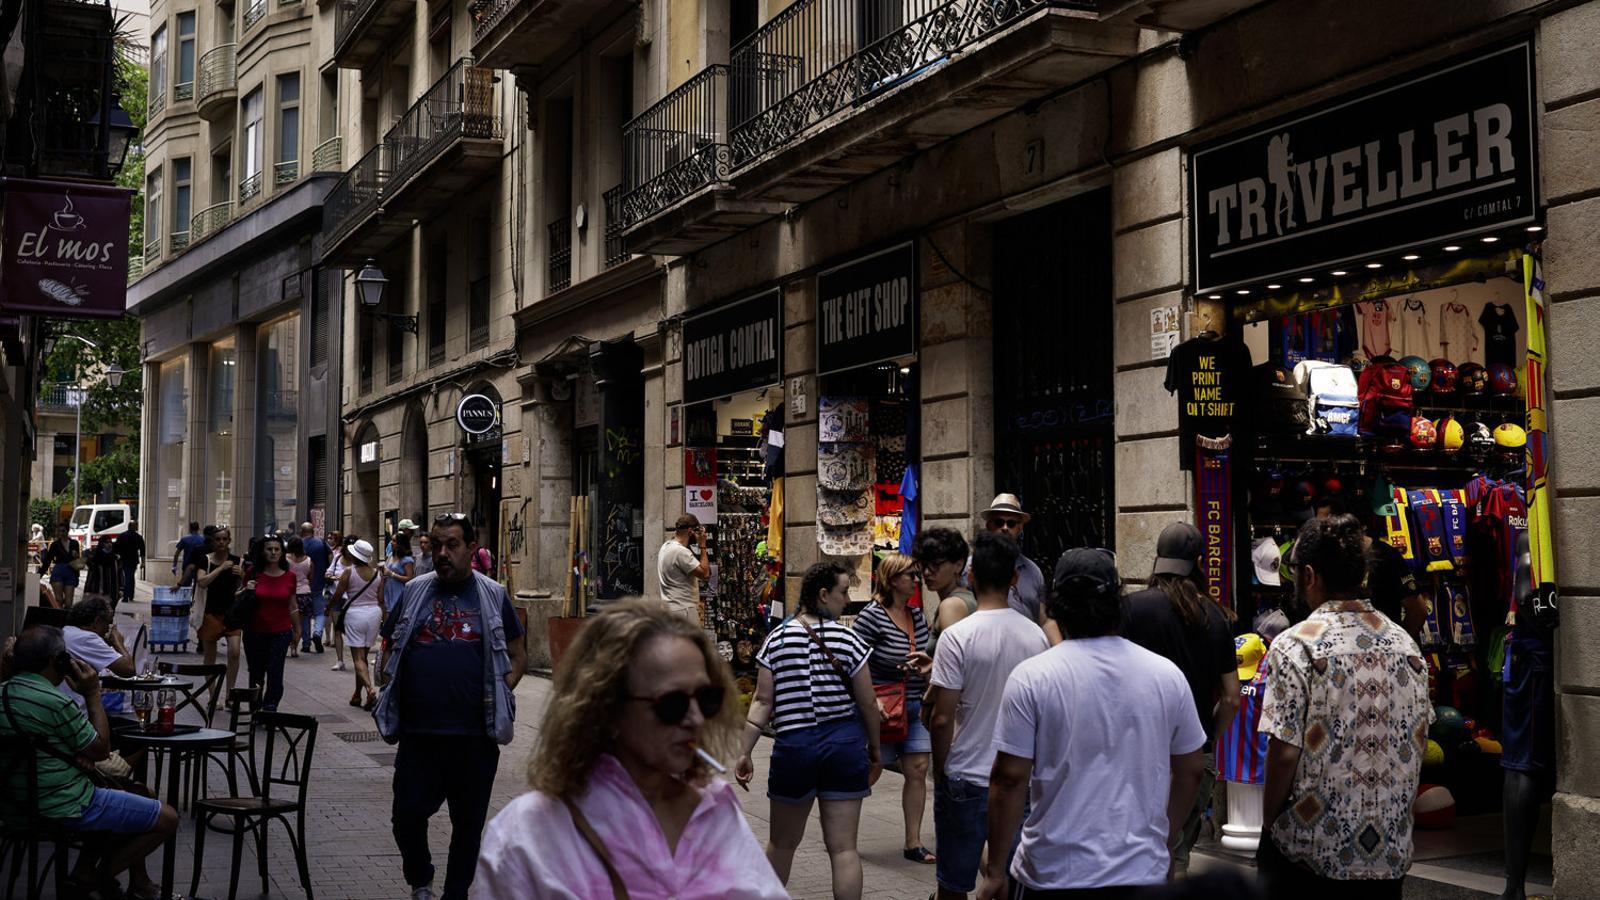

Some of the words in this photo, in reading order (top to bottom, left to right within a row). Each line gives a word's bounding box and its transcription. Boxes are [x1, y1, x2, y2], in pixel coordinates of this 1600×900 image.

[1477, 198, 1512, 217] COMTAL
[1516, 195, 1521, 209] 7
[17, 225, 49, 258] El
[57, 238, 114, 262] mos
[822, 295, 844, 346] THE
[847, 286, 873, 340] GIFT
[874, 275, 909, 333] SHOP
[687, 333, 725, 382] BOTIGA
[730, 317, 776, 371] COMTAL
[1199, 355, 1216, 370] WE
[1191, 371, 1222, 386] PRINT
[1193, 386, 1222, 401] NAME
[463, 409, 493, 417] PANNUS
[1186, 402, 1198, 416] ON
[689, 490, 698, 502] I
[1207, 500, 1220, 521] FC
[1208, 524, 1221, 600] BARCELO
